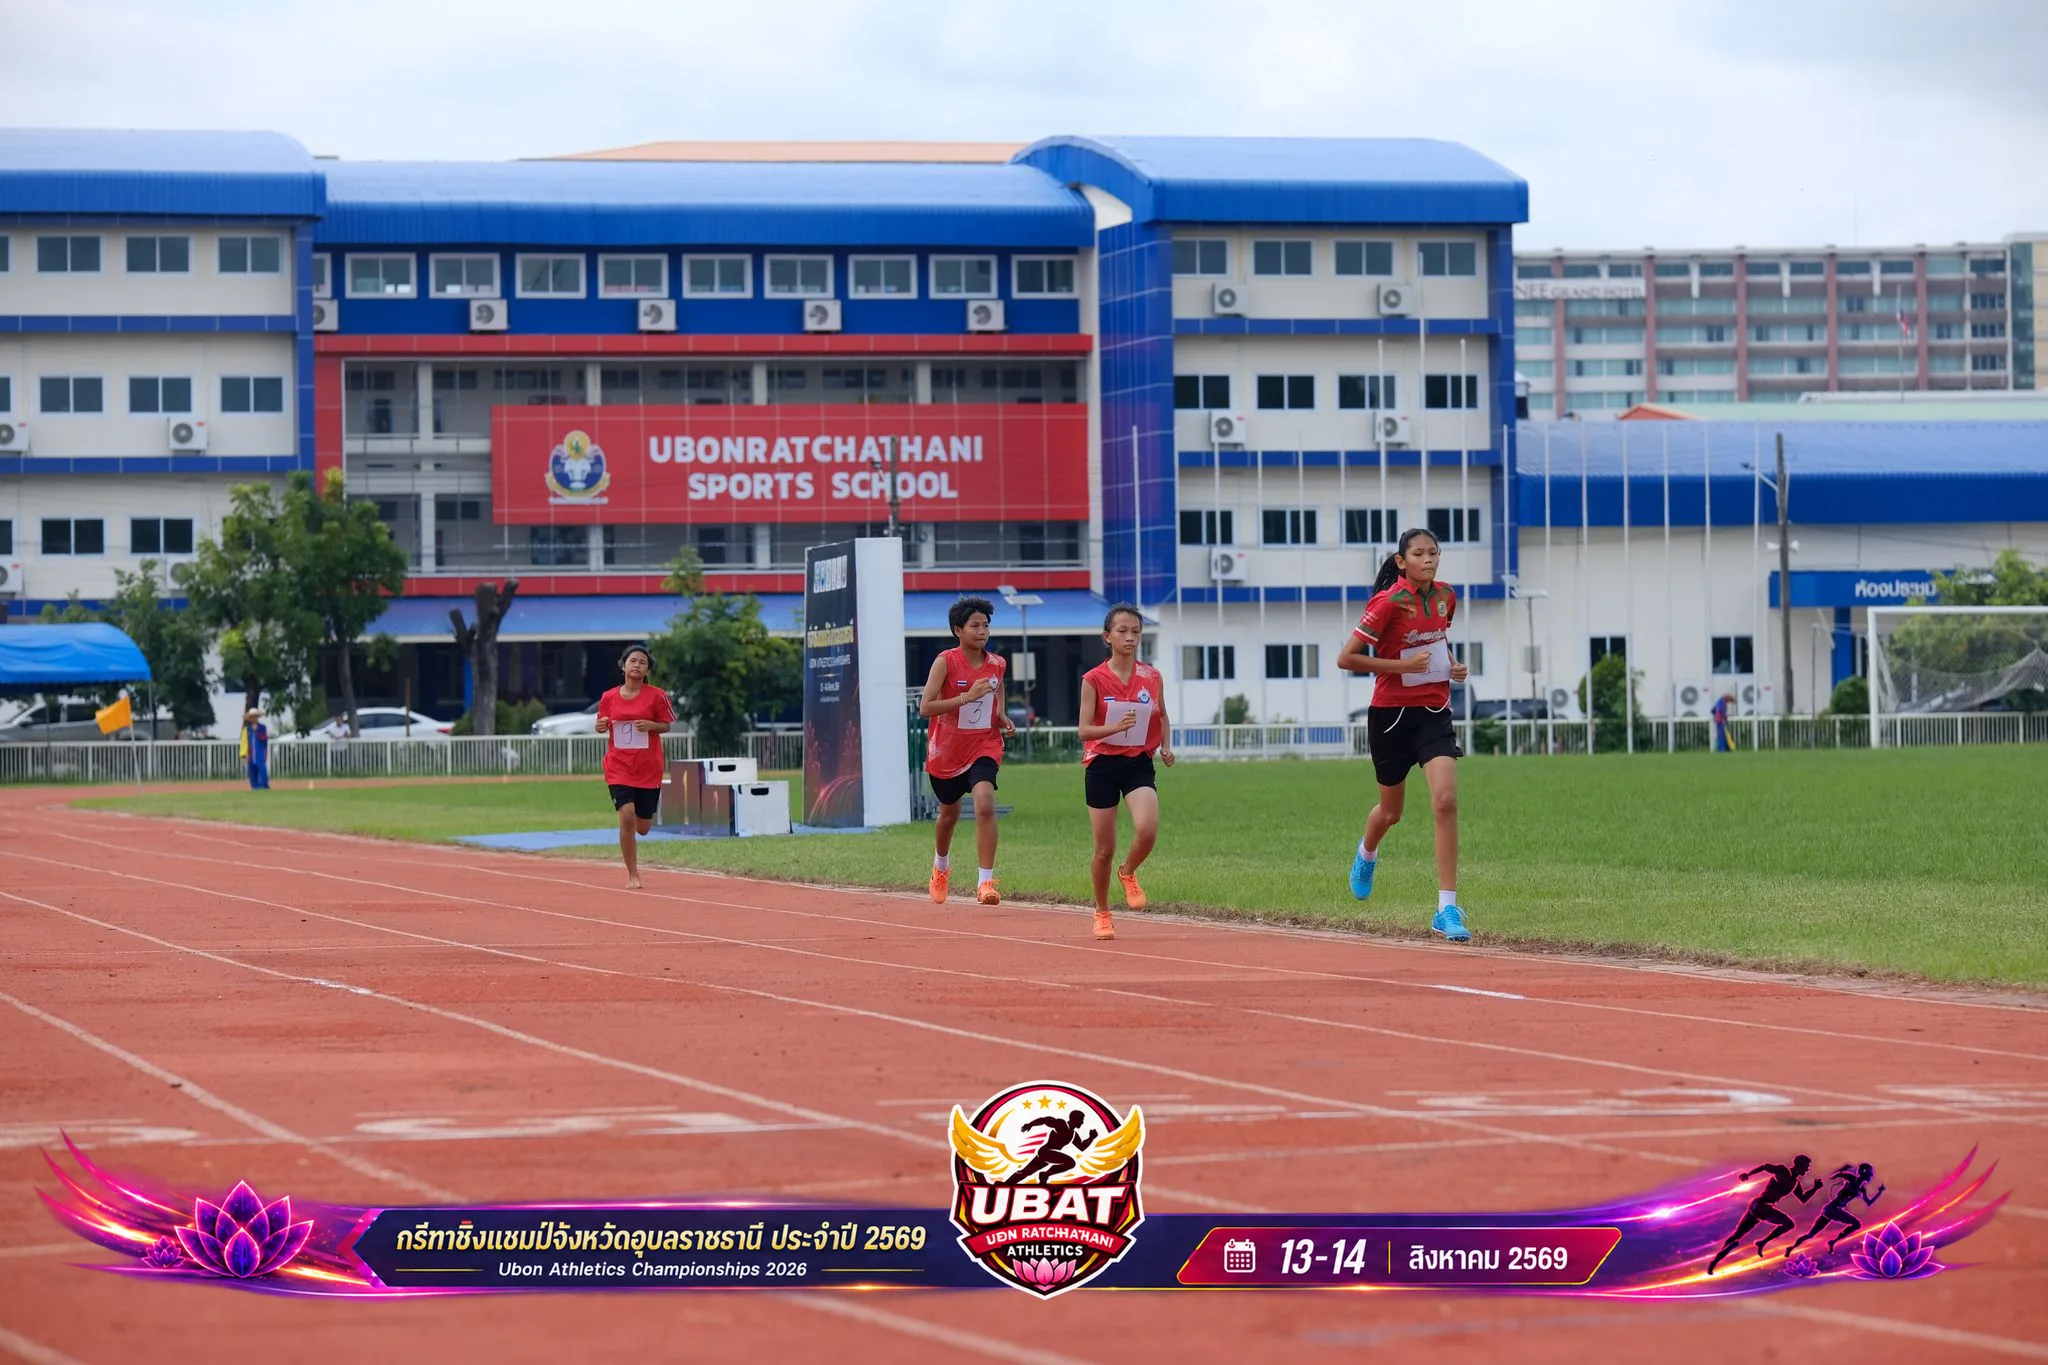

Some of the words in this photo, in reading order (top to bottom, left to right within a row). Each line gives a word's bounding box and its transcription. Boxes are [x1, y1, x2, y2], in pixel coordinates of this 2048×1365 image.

[688, 472, 815, 501] SPORTS
[832, 471, 958, 501] SCHOOL
[968, 700, 984, 724] 3
